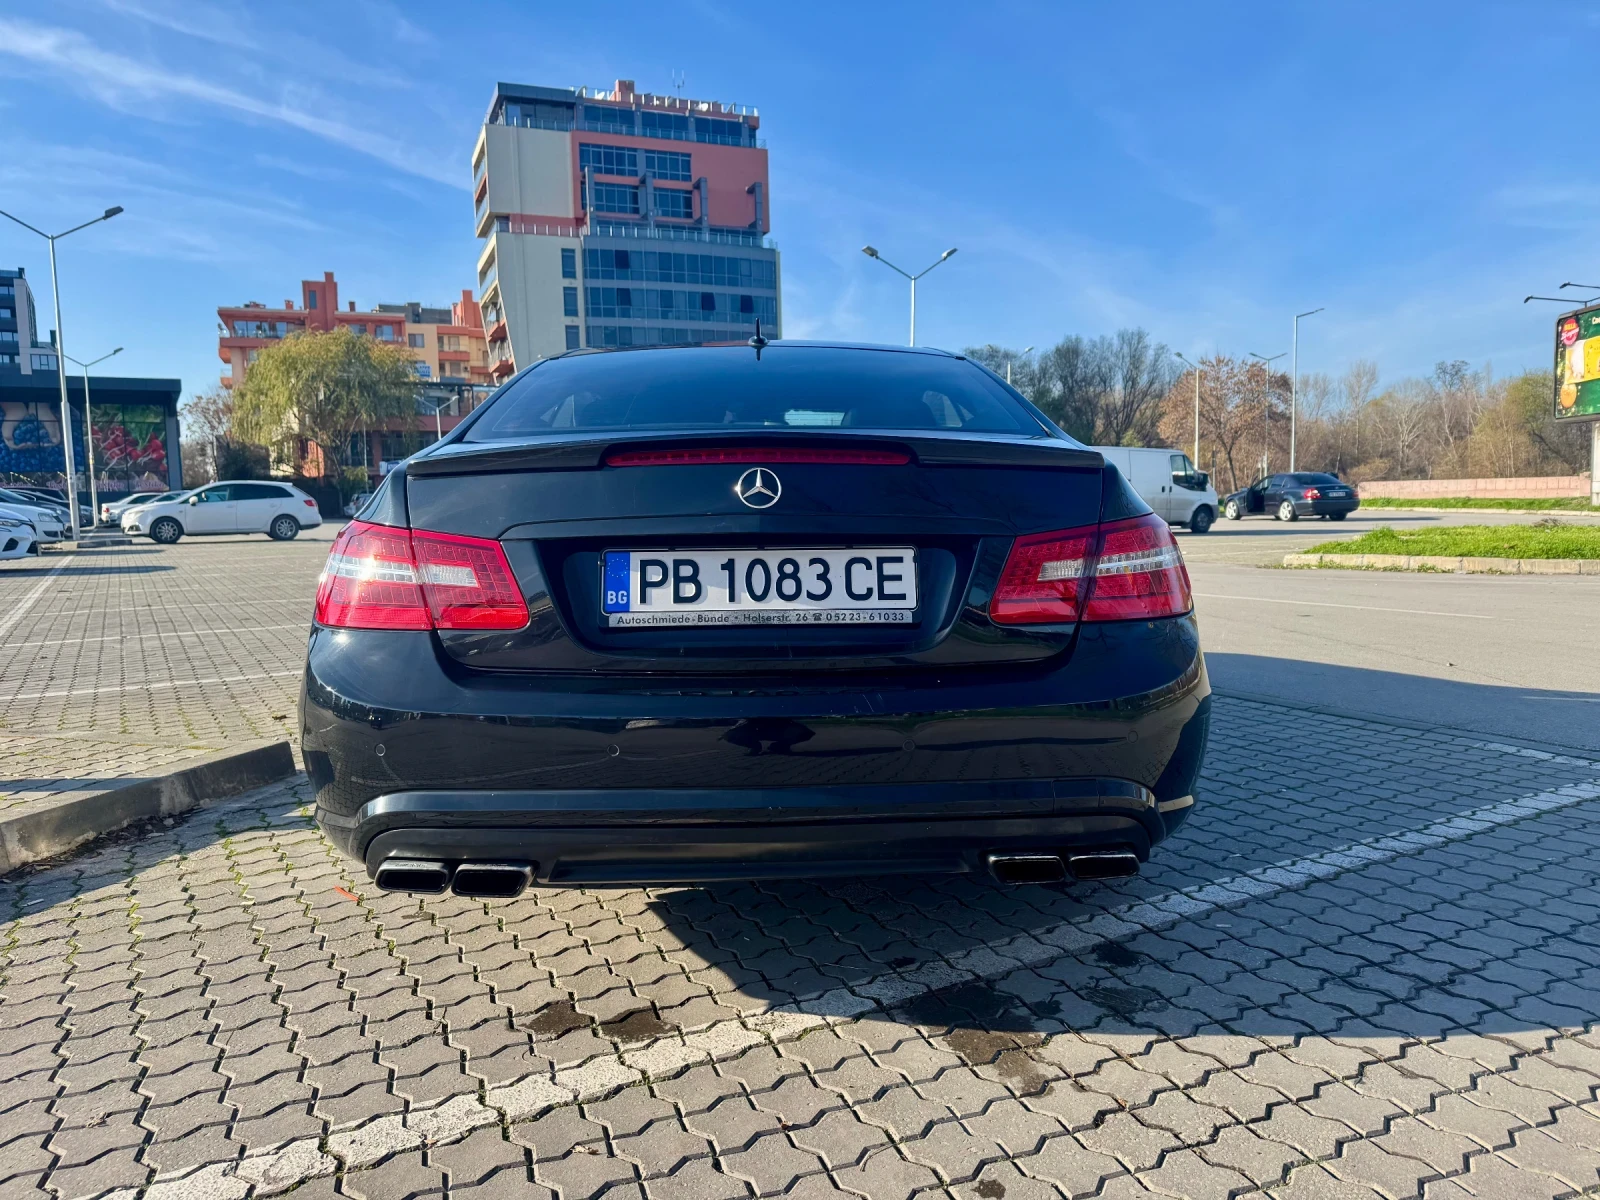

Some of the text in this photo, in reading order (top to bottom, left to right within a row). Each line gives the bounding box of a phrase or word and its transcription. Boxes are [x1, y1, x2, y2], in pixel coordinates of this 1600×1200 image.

[639, 556, 907, 604] PB 1083 CE
[607, 590, 628, 605] BG
[795, 612, 808, 622] 26
